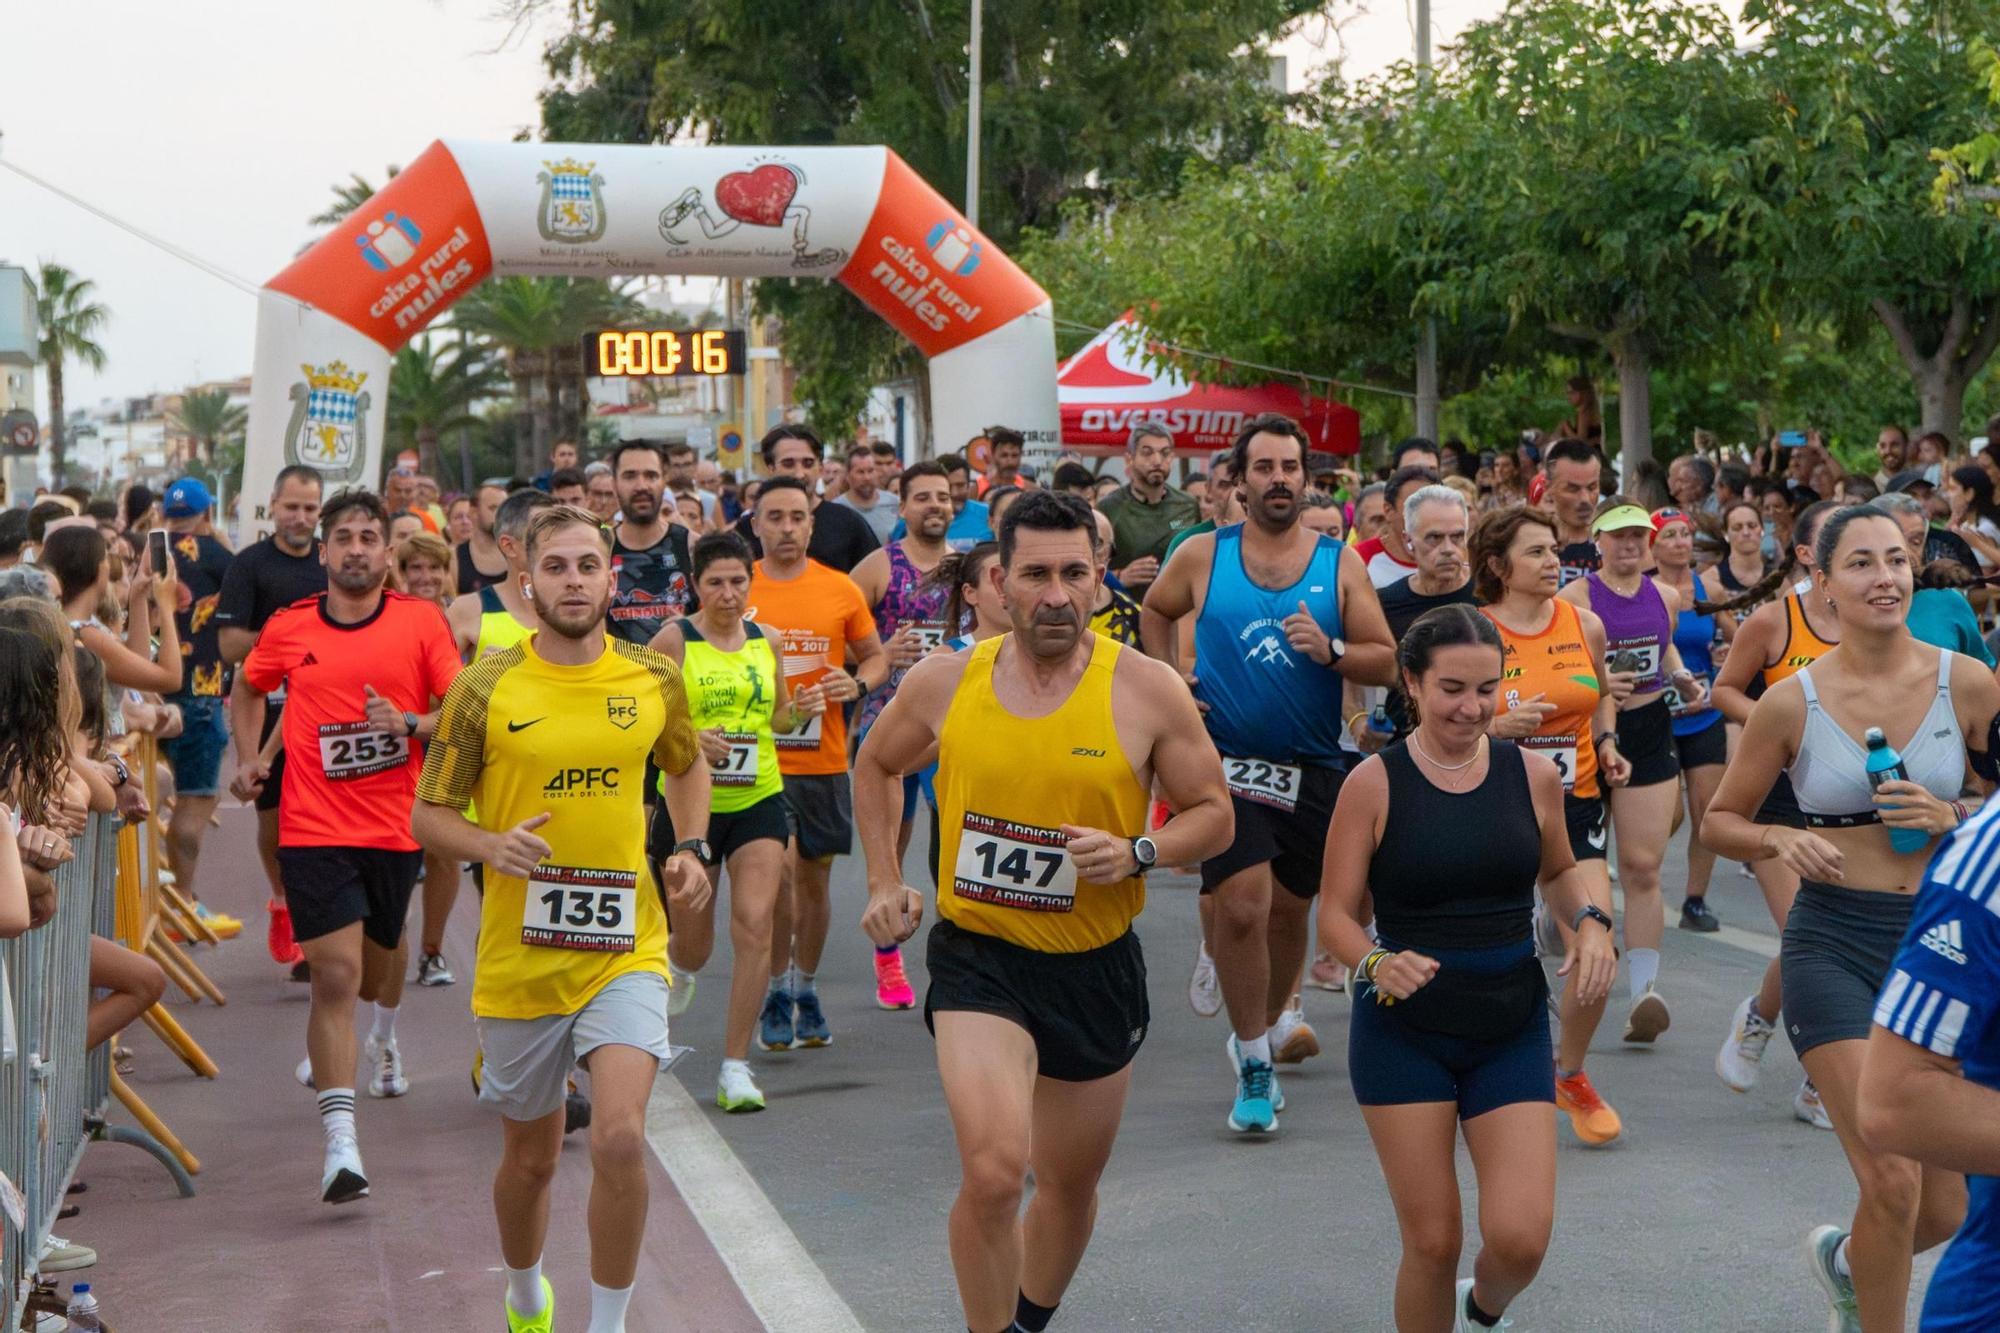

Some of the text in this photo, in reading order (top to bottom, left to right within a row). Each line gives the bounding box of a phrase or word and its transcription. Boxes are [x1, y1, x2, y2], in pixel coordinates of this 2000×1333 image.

[370, 226, 471, 318] caixa rural
[881, 235, 982, 323] caixa rural
[394, 258, 474, 329] nules
[871, 261, 950, 331] nules
[607, 706, 638, 718] PFC
[330, 734, 401, 765] 253
[1072, 747, 1106, 758] 2XU
[1230, 762, 1292, 793] 223
[543, 791, 575, 799] COSTA
[965, 813, 995, 834] RUN
[532, 866, 637, 888] RUN ADDICTION
[975, 840, 1064, 888] 147
[541, 888, 622, 929] 135
[954, 880, 1073, 911] RUN ADDICTION
[522, 929, 635, 952] RUN ADDICTION
